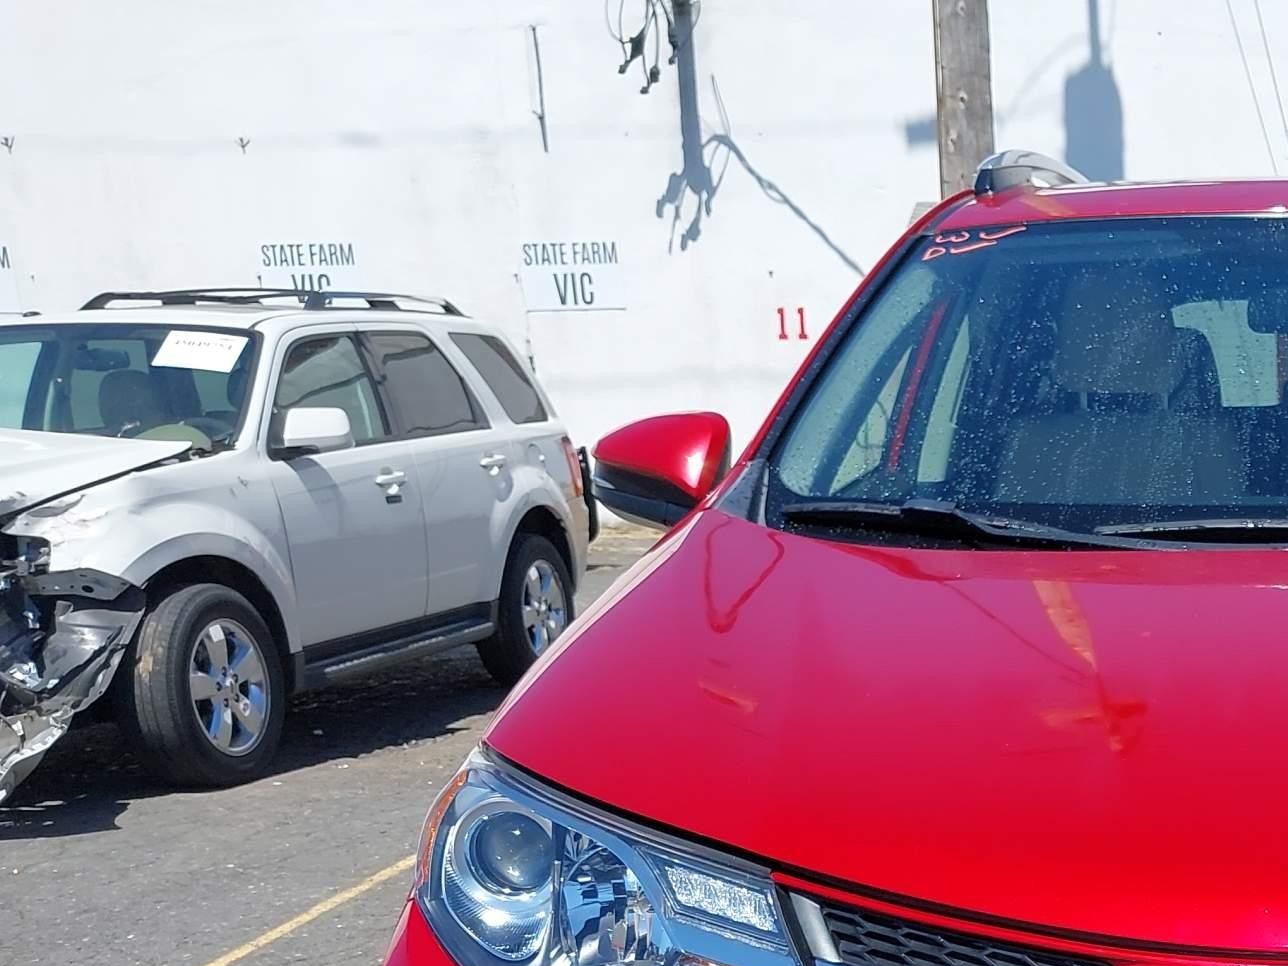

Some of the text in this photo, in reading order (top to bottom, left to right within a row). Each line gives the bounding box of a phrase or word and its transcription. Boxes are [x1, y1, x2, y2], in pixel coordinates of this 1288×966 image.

[261, 243, 355, 266] STATE FARM
[522, 241, 618, 266] STATE FARM
[553, 272, 594, 305] VIC
[777, 307, 808, 340] 11
